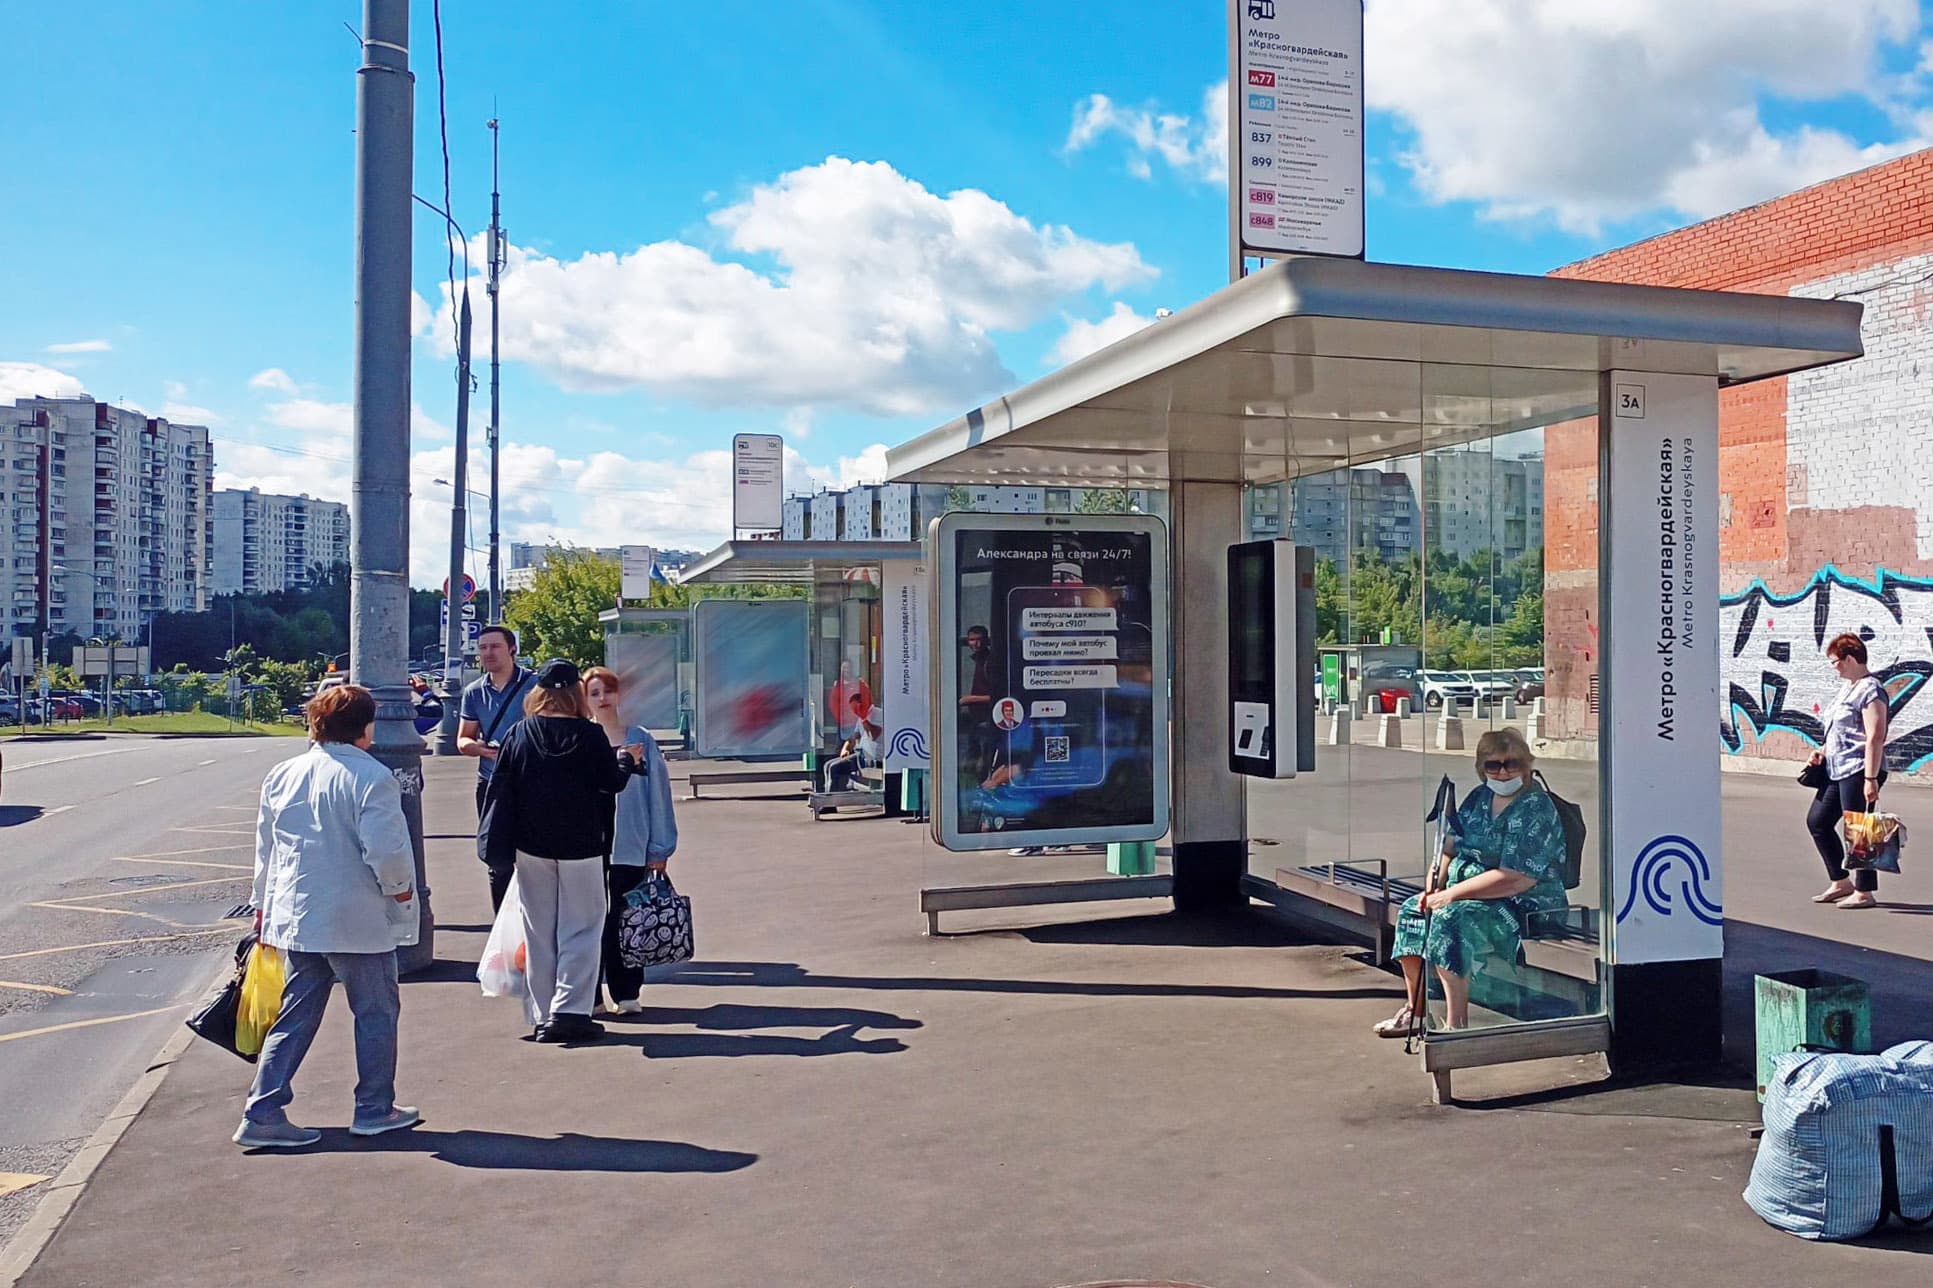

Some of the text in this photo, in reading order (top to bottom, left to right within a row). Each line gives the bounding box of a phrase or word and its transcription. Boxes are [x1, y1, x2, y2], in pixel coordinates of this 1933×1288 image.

[1248, 28, 1280, 41] Метро
[1248, 39, 1348, 60] «Красногвардейская»
[1251, 131, 1272, 144] 837
[1251, 156, 1273, 168] 899
[1681, 437, 1697, 650] Metro Krasnogvardeyskaya
[976, 547, 1132, 560] Александра на связи 24/7!
[1657, 436, 1678, 742] Метро «Красногвардейская»
[1029, 640, 1060, 649] Почему
[1078, 639, 1108, 648] автобус
